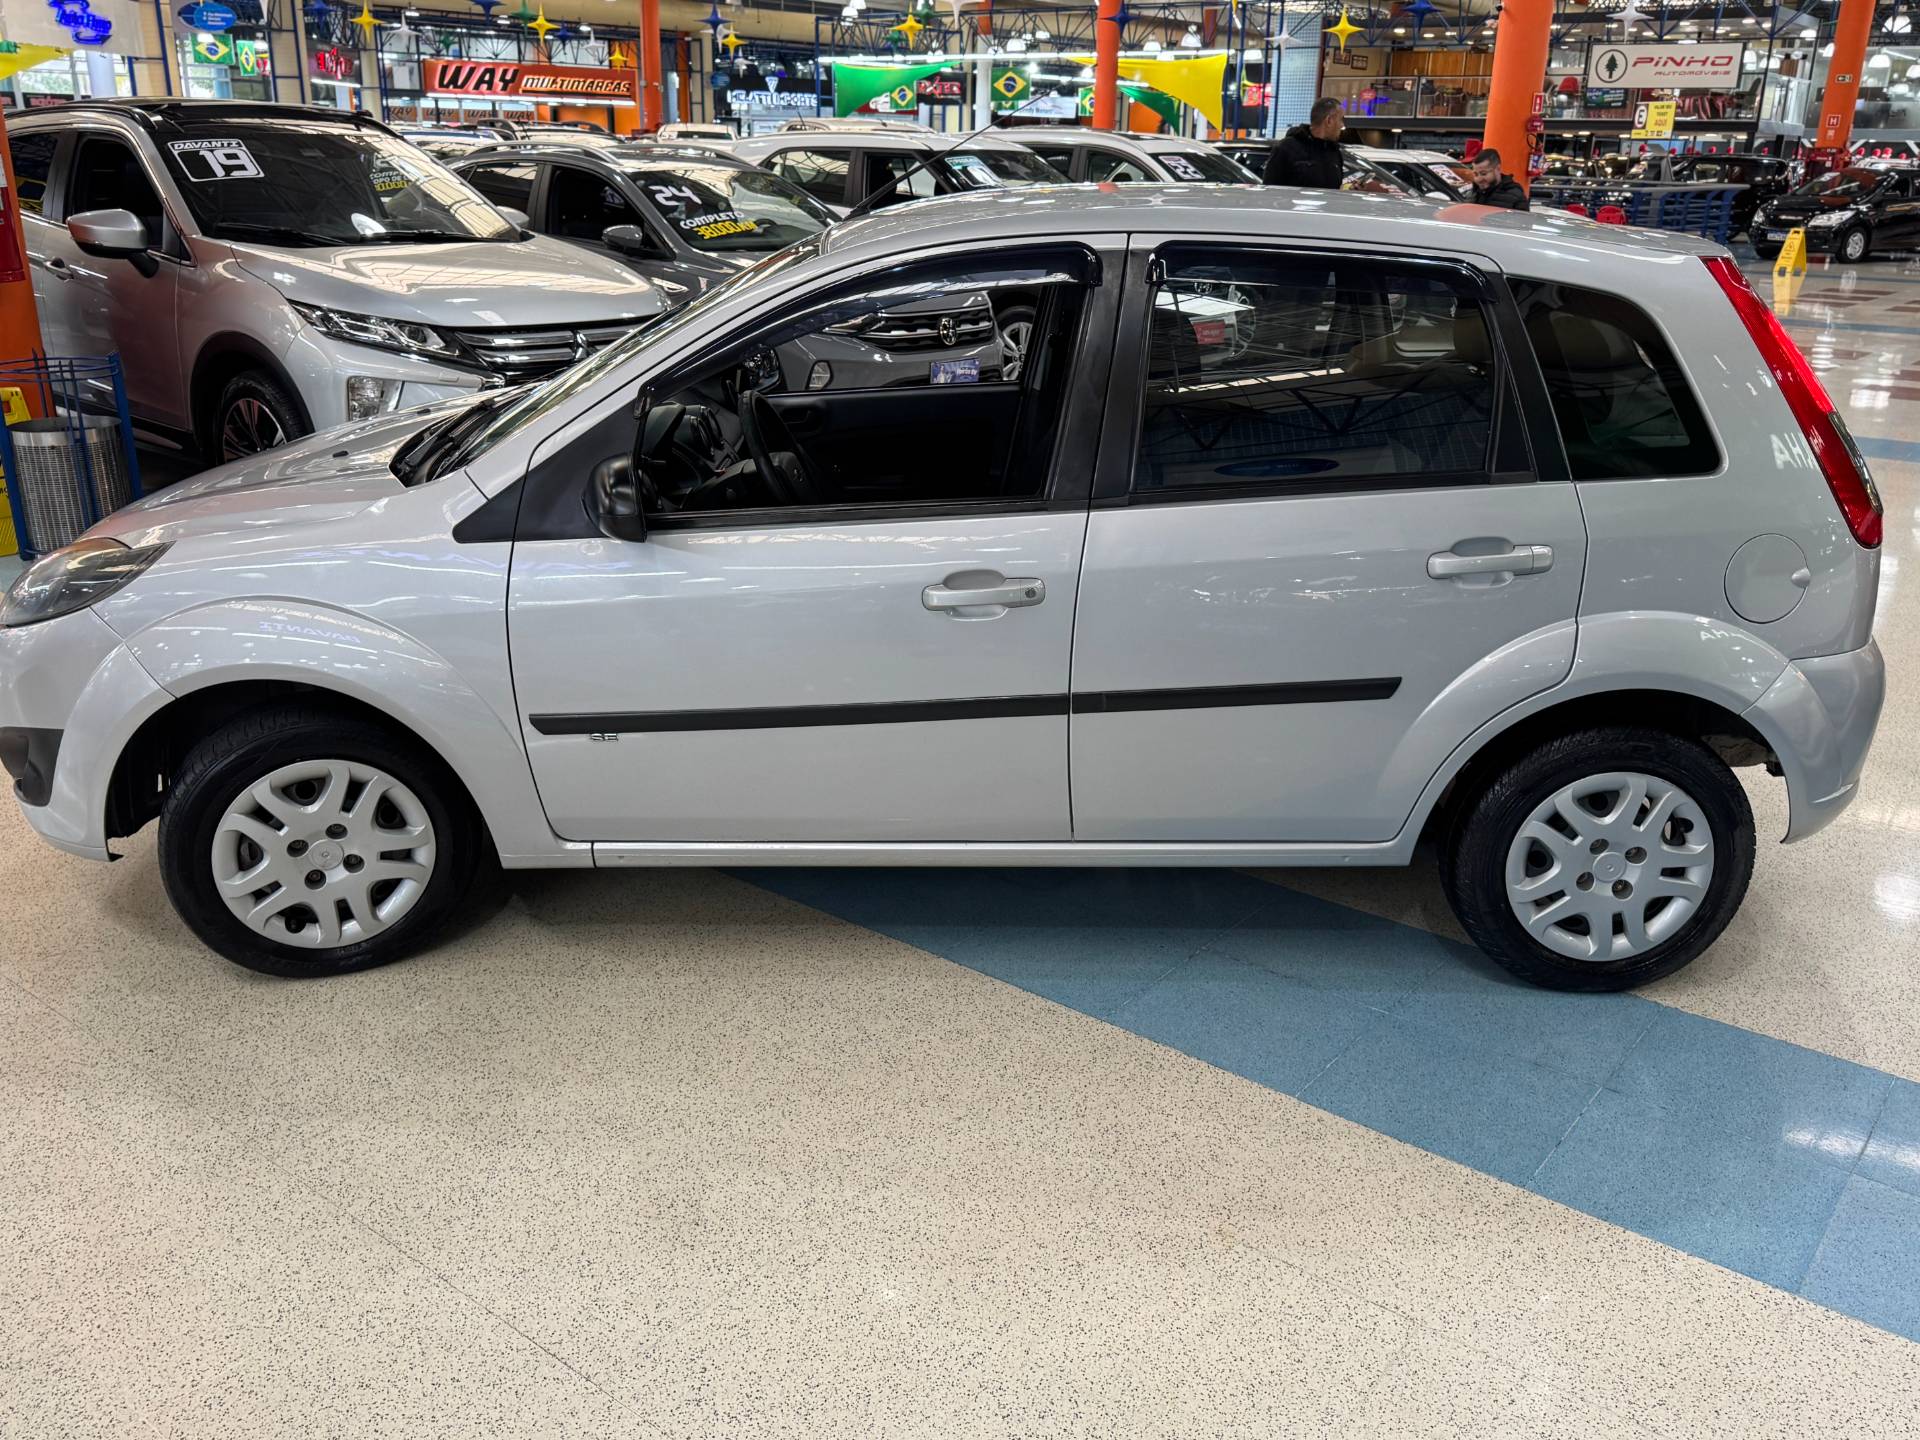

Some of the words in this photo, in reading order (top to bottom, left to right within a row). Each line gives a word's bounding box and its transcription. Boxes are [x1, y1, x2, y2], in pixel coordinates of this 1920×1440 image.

[438, 63, 521, 92] WAY
[1637, 109, 1646, 125] E
[1829, 117, 1838, 125] H
[173, 140, 239, 150] DAVANTI
[198, 149, 259, 178] 19
[648, 185, 703, 206] 24
[679, 210, 745, 229] COMPLETO
